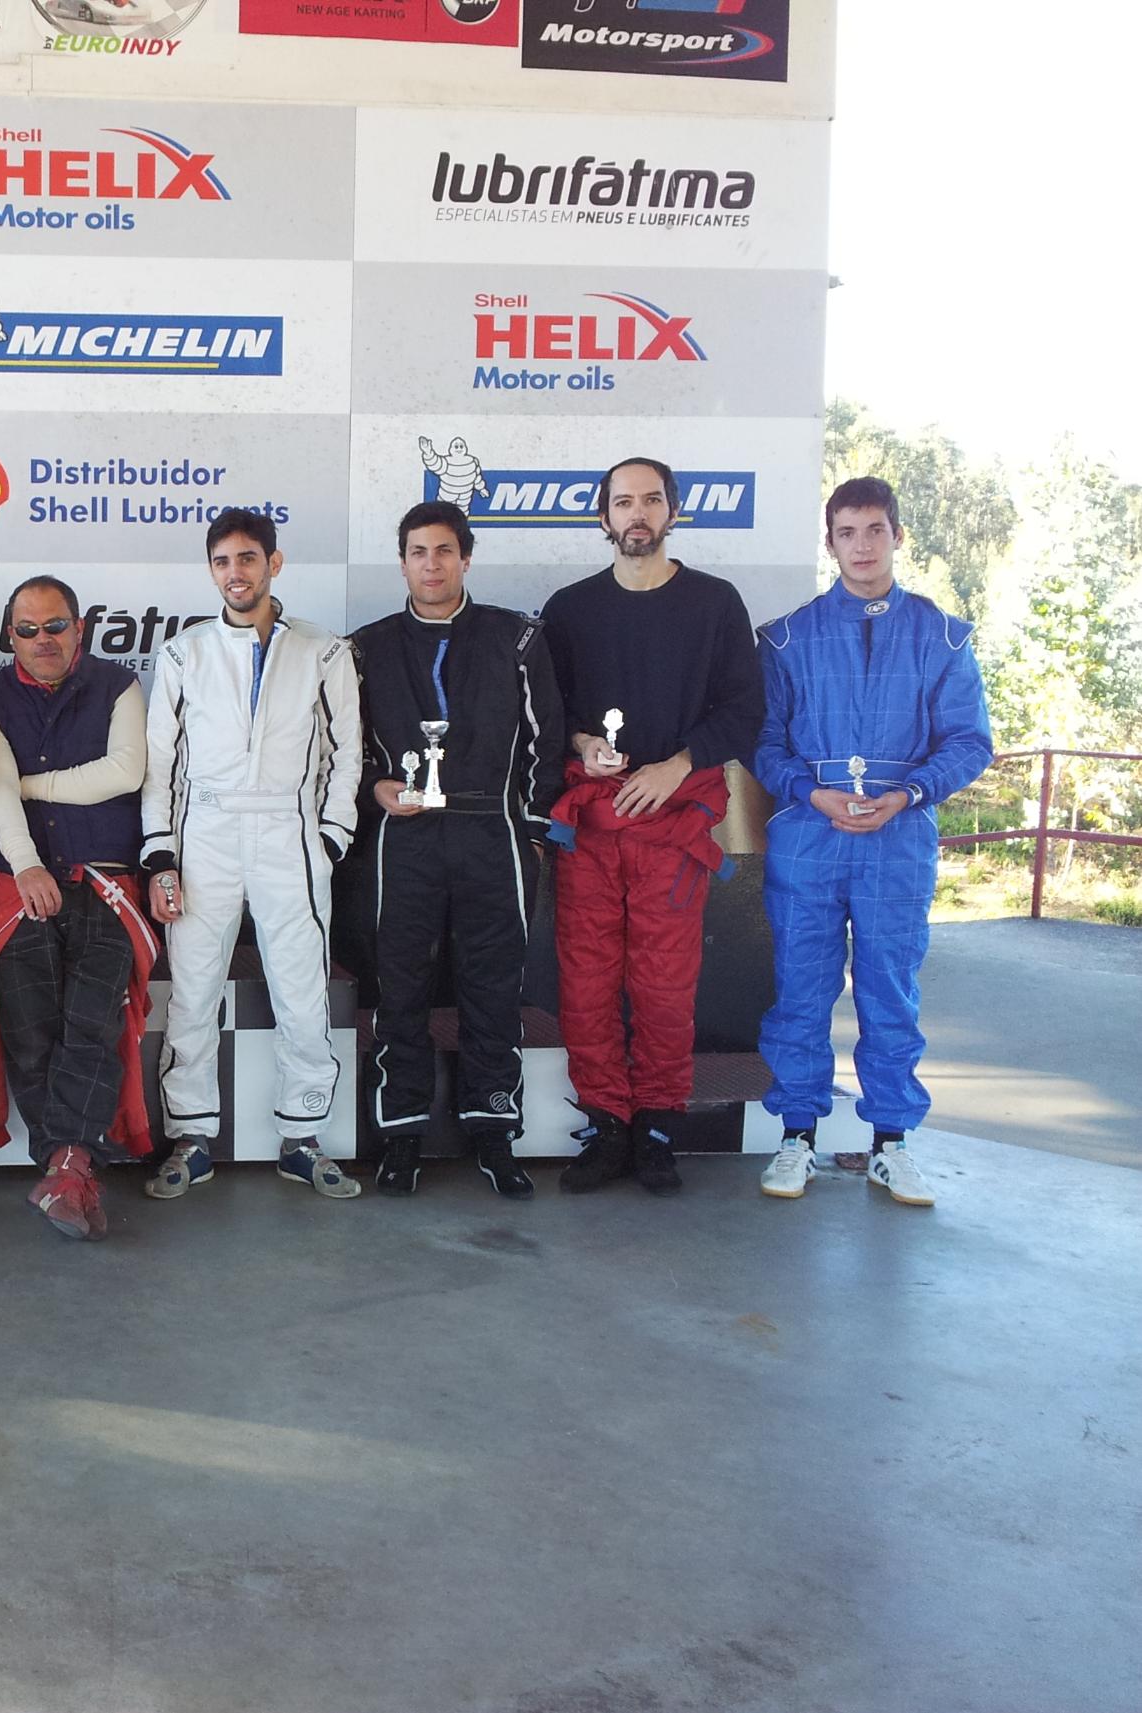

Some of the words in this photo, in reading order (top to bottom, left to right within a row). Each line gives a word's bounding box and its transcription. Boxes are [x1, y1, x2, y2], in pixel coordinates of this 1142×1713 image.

[296, 5, 324, 16] NEW
[324, 6, 351, 17] AGE
[354, 7, 406, 19] KARTING
[53, 34, 182, 56] EUROINDY
[540, 23, 735, 52] Motorsport
[84, 205, 136, 231] oils
[435, 207, 548, 224] ESPECIALISTAS
[550, 210, 575, 224] EM
[575, 211, 624, 225] PNEUS
[626, 212, 637, 226] E
[638, 212, 751, 228] LUBRIFICANTES
[474, 293, 529, 308] Shell
[5, 325, 273, 359] MICHELIN
[473, 314, 699, 362] HELIX
[472, 366, 561, 391] Motor
[565, 366, 616, 391] oils
[29, 458, 227, 487] Distribuidor
[29, 496, 109, 524] Shell
